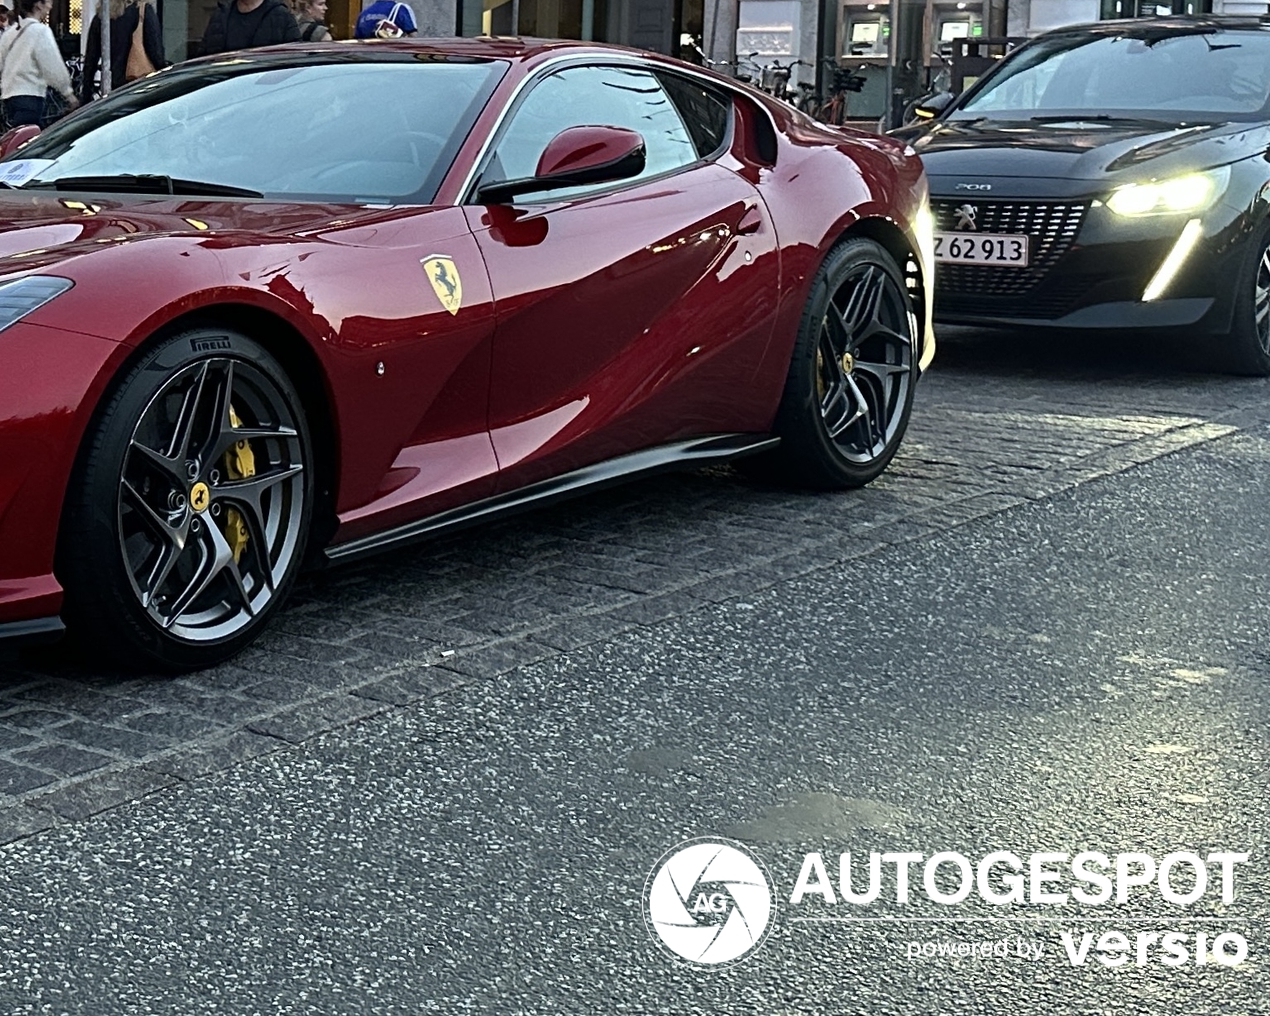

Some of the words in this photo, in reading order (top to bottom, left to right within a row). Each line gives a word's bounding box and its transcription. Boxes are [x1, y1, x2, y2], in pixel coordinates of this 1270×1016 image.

[949, 237, 975, 258] 62
[981, 239, 1022, 260] 913
[190, 336, 231, 352] PIRELLI
